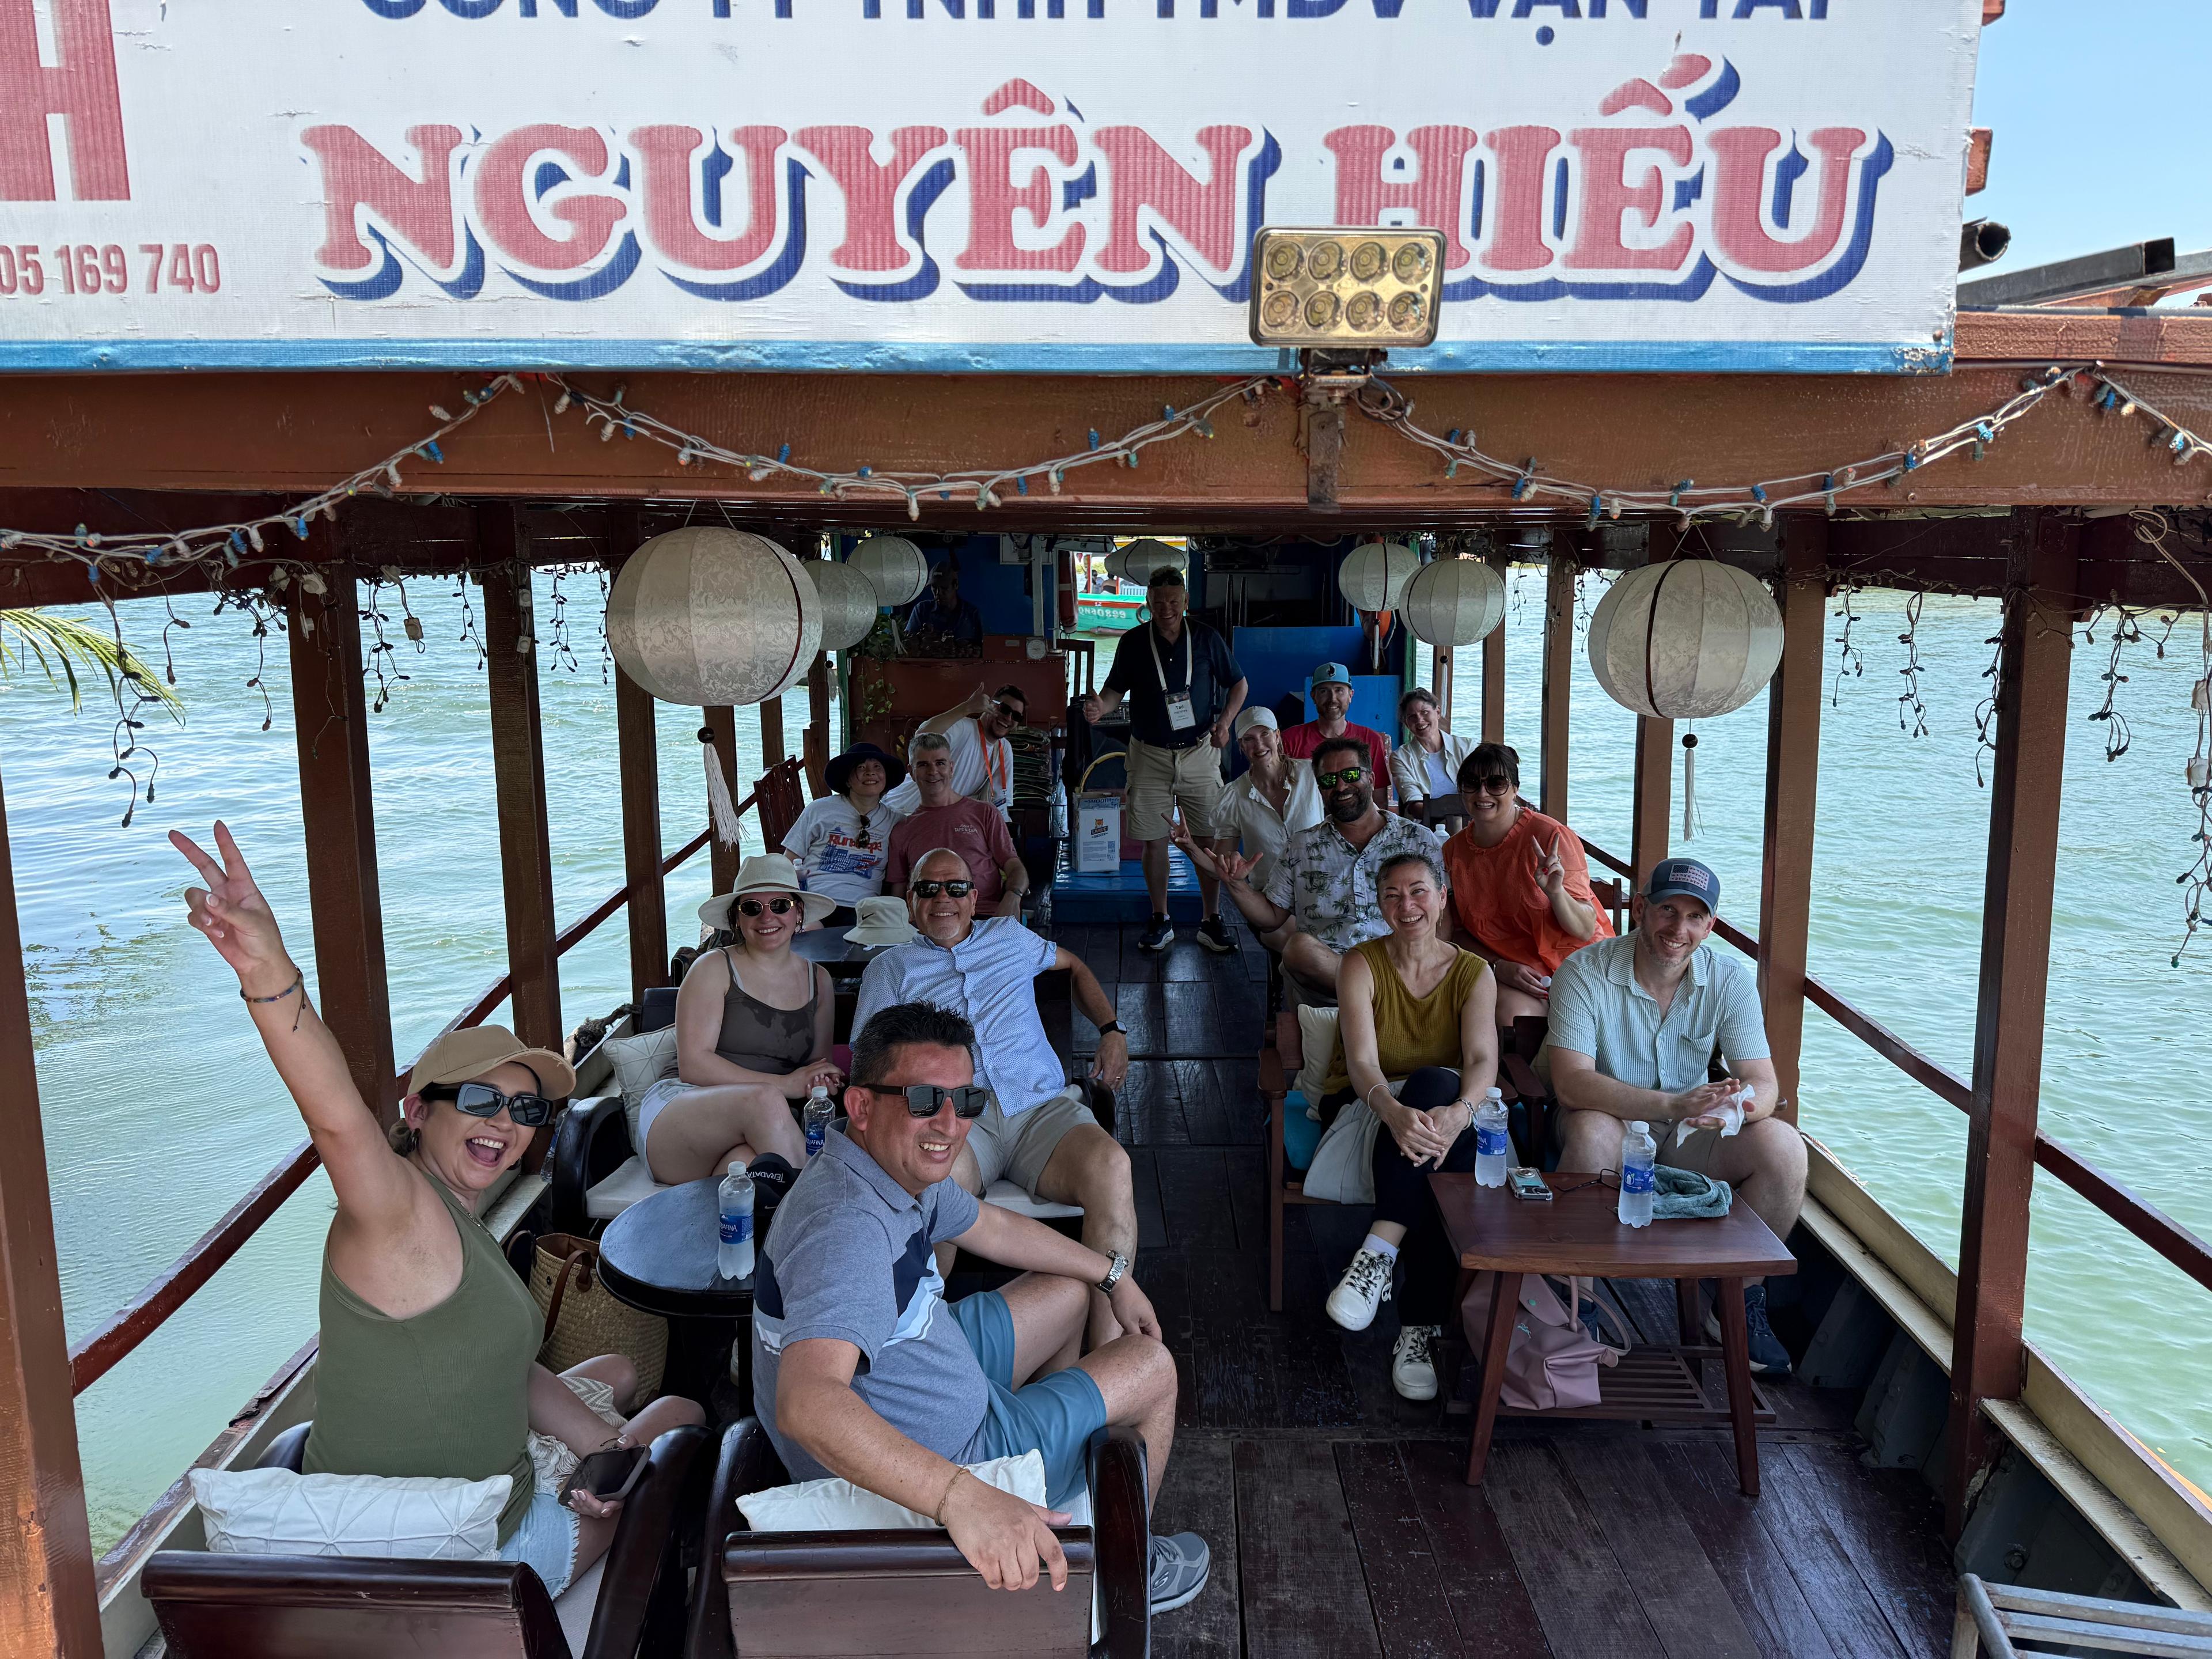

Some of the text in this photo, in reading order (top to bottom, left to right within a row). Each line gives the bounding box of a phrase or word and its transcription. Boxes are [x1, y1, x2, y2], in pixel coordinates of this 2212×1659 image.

[301, 54, 1894, 304] NGUYÊN HIẾU
[54, 244, 127, 295] 169
[138, 243, 221, 294] 740
[746, 1171, 786, 1183] TERADATA
